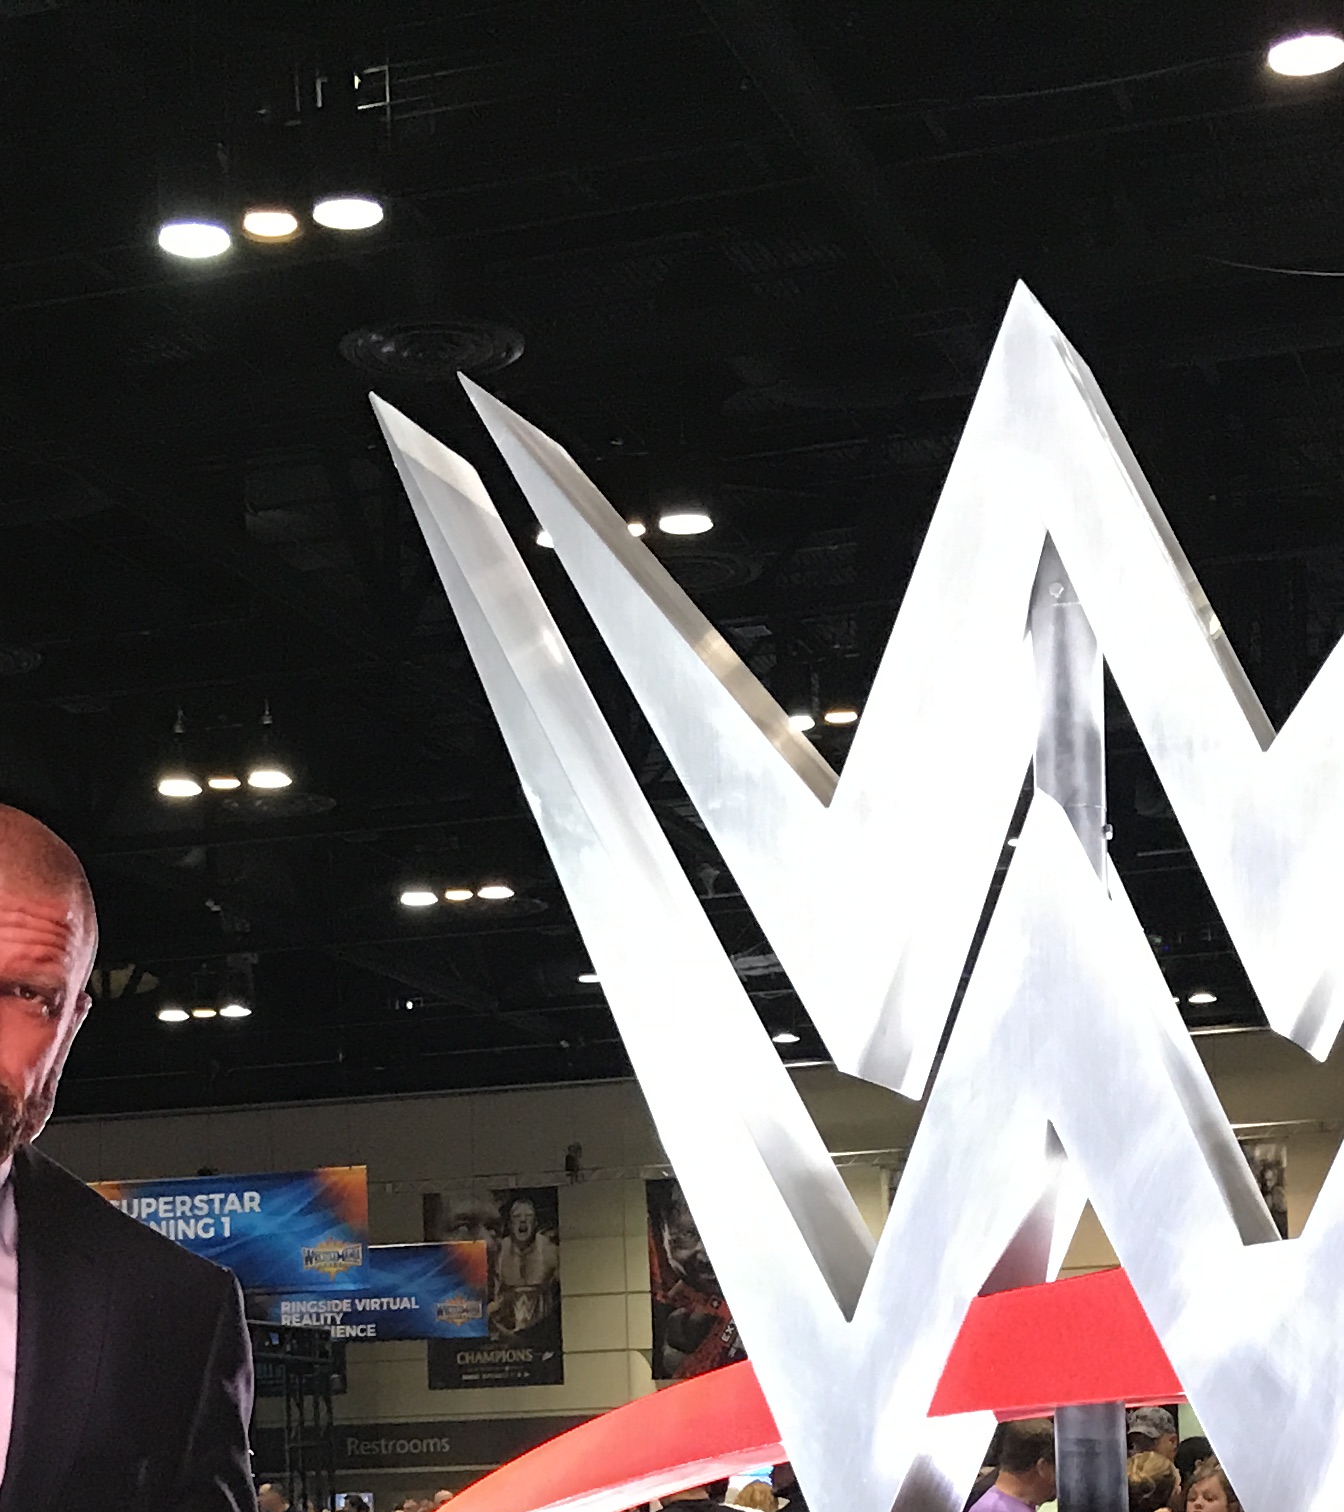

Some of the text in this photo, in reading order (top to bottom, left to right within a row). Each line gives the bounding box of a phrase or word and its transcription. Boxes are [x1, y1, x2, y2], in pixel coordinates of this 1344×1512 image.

[147, 1217, 215, 1241] NING
[281, 1296, 419, 1314] RINGSIDE VIRTUAL
[281, 1312, 344, 1327] REALITY
[328, 1324, 377, 1338] IENCE
[457, 1348, 534, 1365] CHAMPIONS
[346, 1435, 451, 1456] Restrooms
